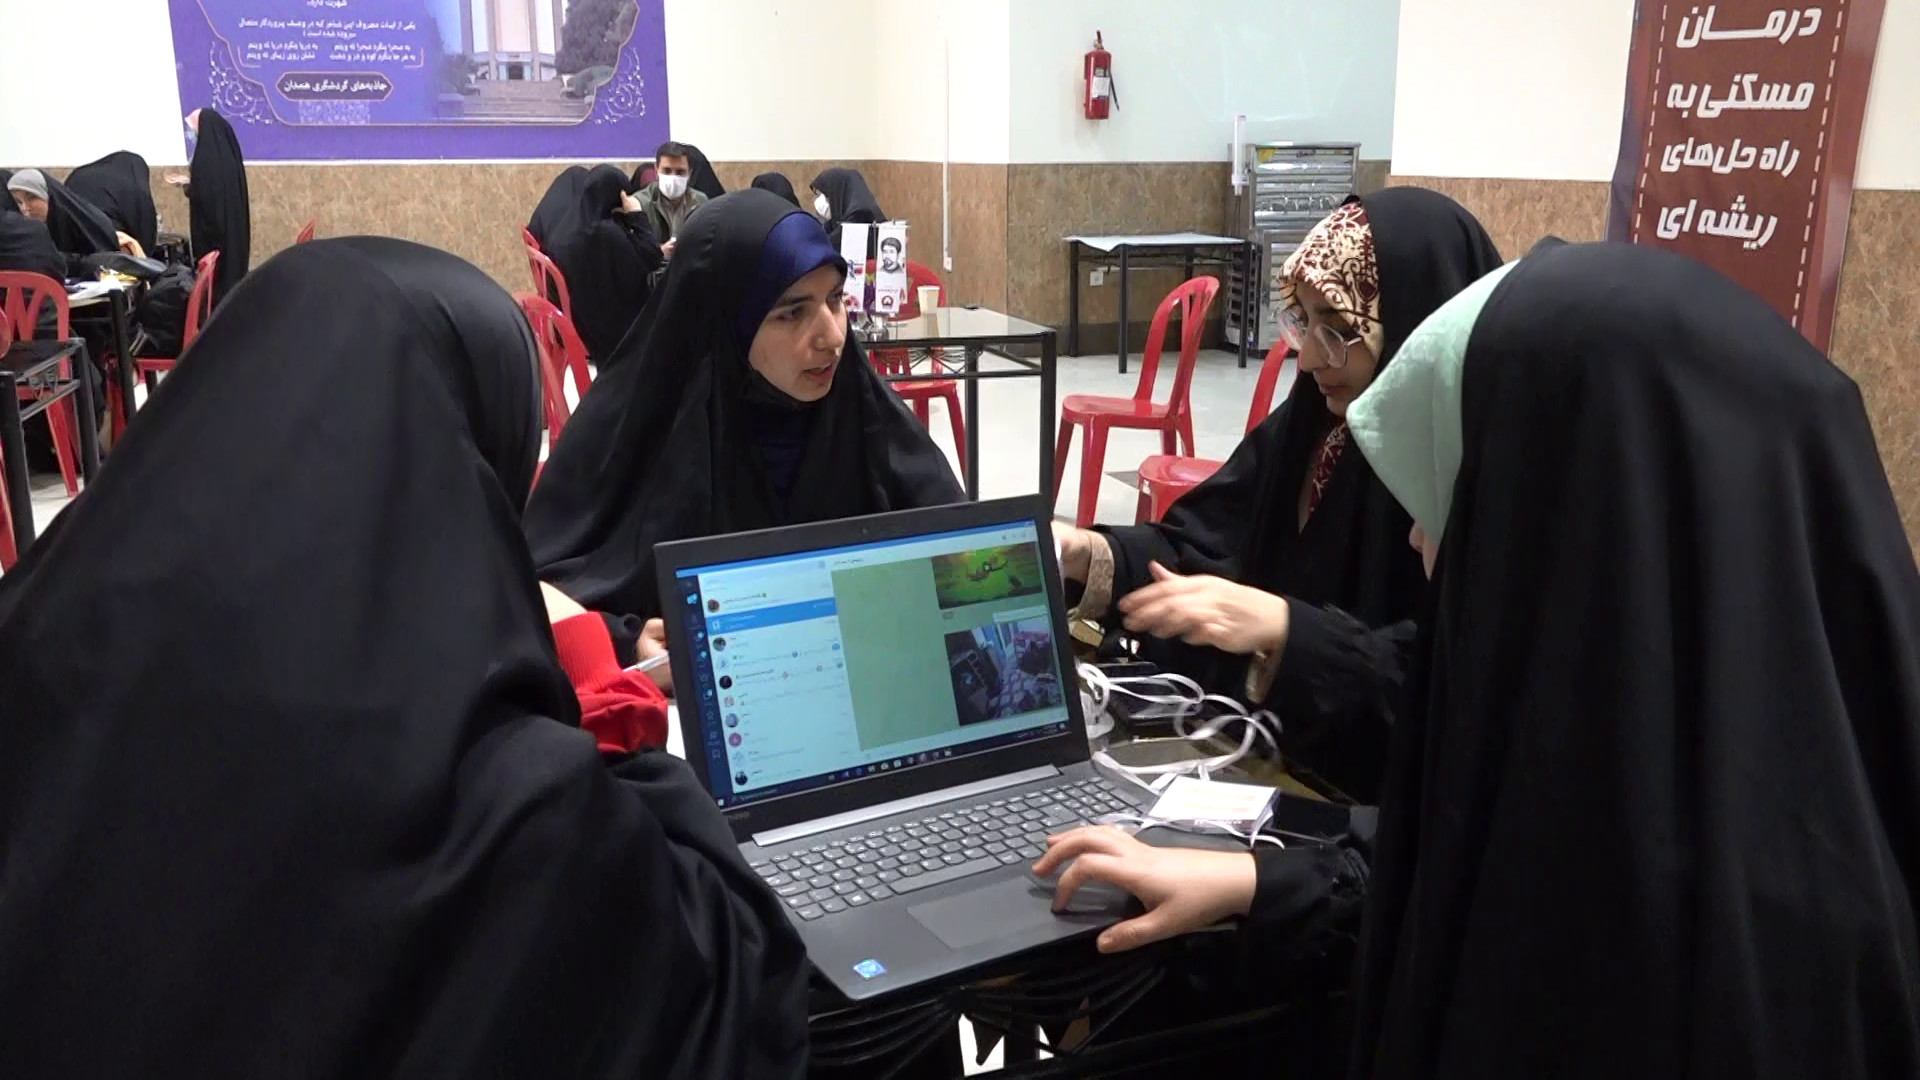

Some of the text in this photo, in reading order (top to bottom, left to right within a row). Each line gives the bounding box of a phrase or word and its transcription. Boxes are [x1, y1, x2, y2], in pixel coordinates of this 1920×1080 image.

[1676, 5, 1823, 48] درمان
[284, 79, 310, 92] همدان
[312, 79, 348, 92] گردشگری
[1666, 73, 1815, 118] مسکنی به
[1759, 140, 1800, 177] راه
[1656, 194, 1778, 250] ریشه ای
